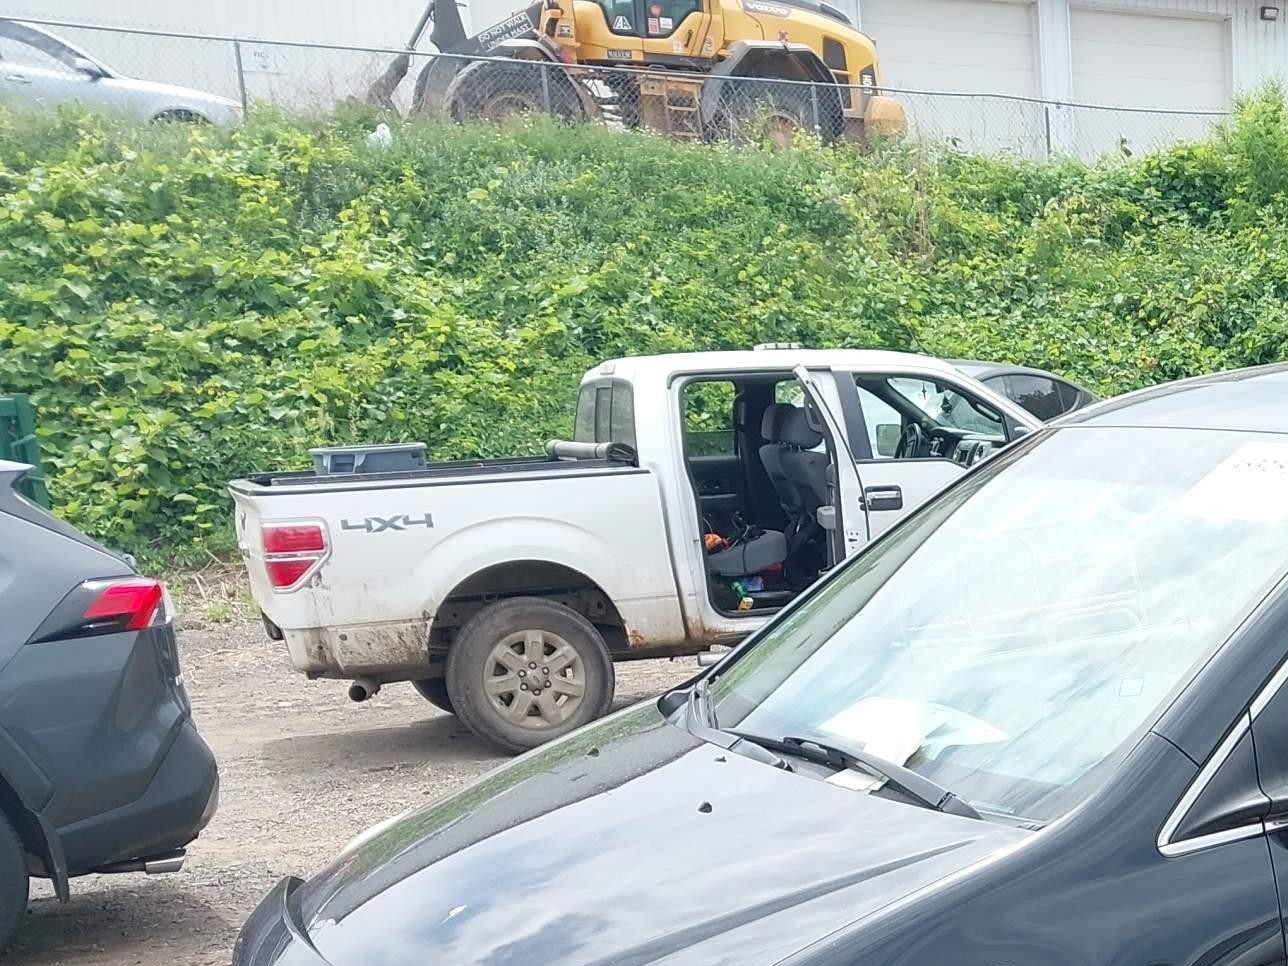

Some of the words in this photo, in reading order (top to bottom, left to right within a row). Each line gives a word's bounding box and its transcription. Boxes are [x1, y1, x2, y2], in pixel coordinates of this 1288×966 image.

[746, 3, 788, 15] VOLVO
[490, 24, 506, 36] NOT
[507, 13, 528, 27] WALK
[510, 23, 530, 37] MAST
